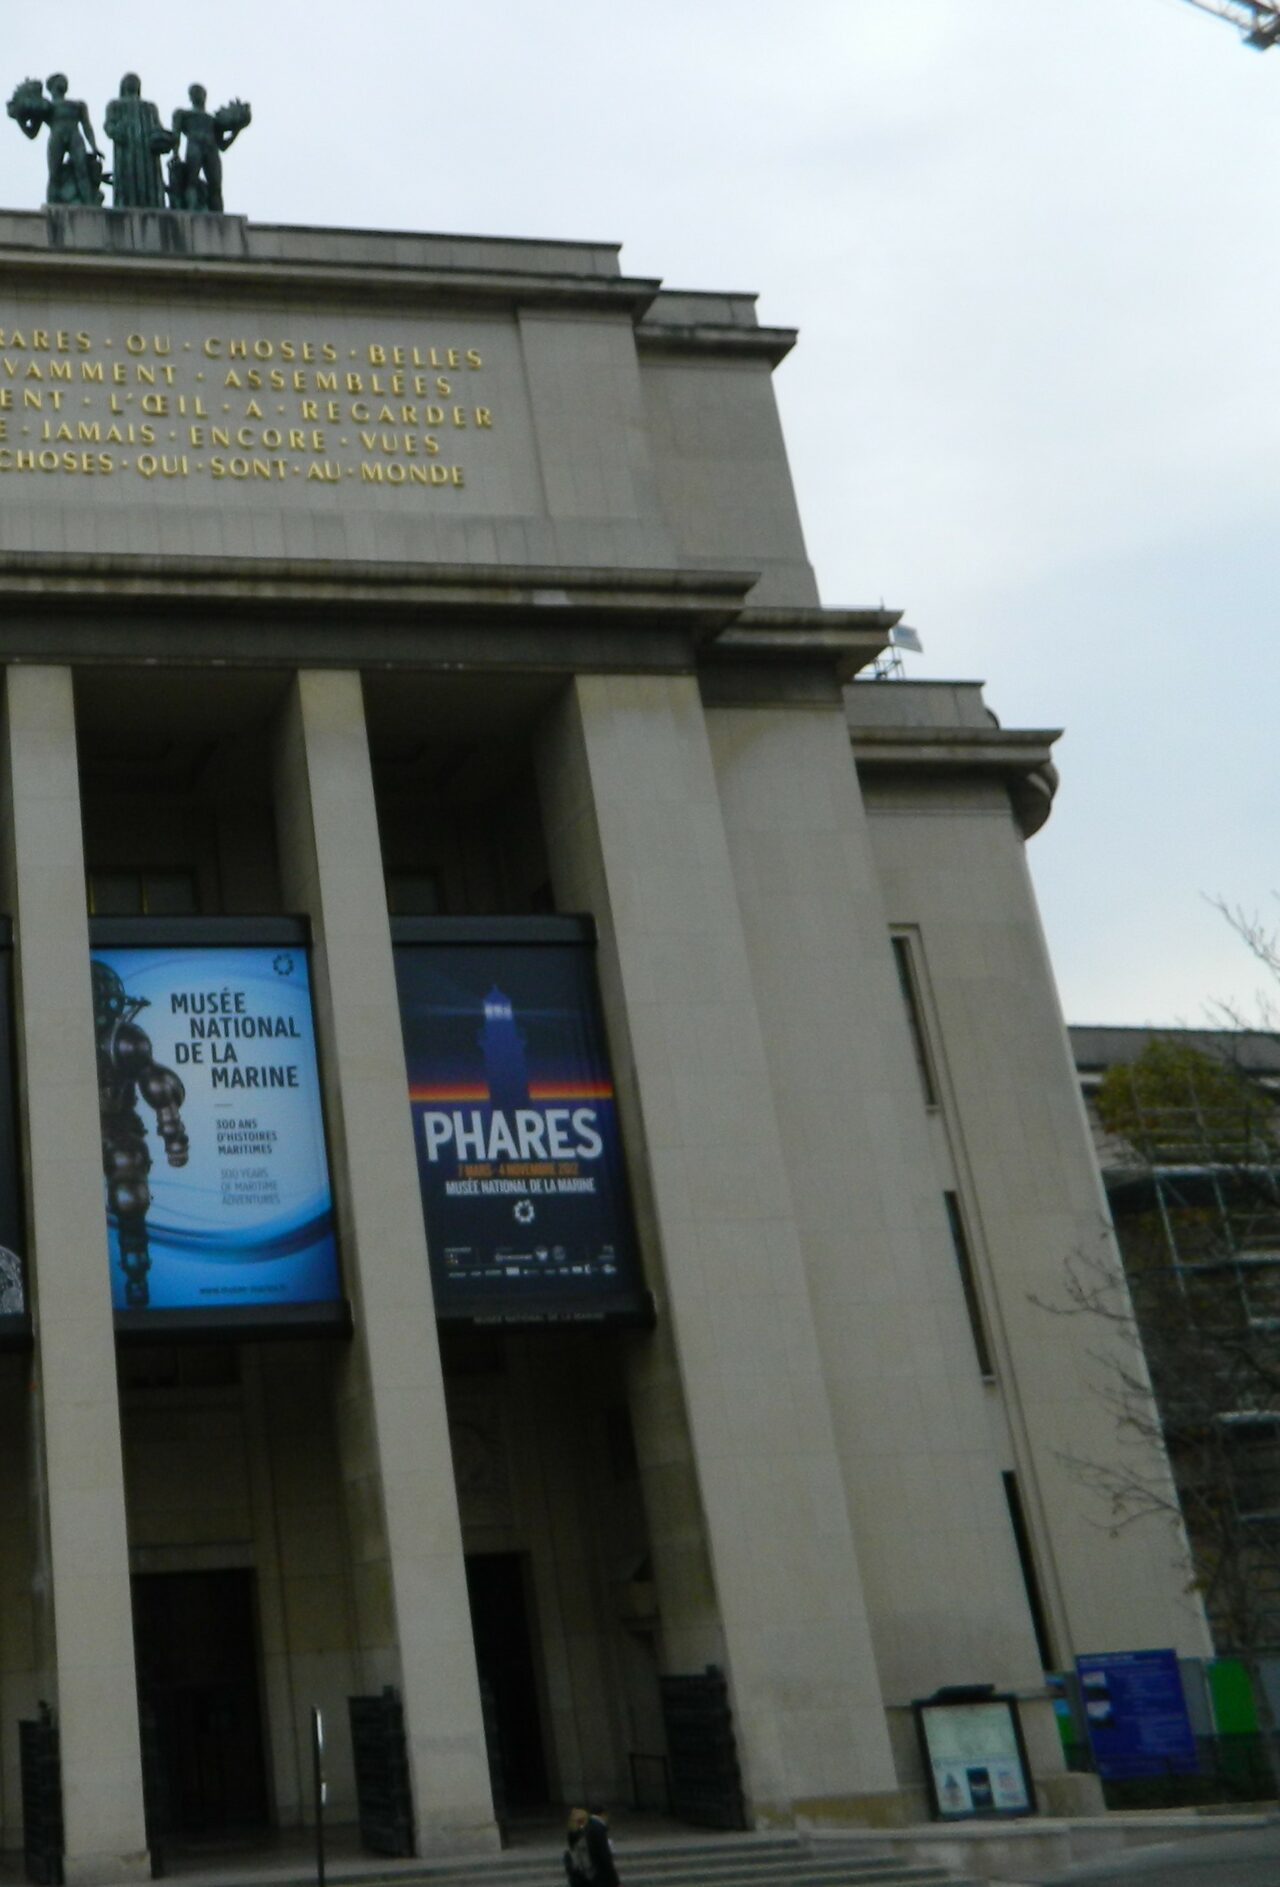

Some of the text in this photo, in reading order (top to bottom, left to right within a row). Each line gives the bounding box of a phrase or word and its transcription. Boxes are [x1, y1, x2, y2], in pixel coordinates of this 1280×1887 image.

[127, 334, 171, 356] OU
[205, 338, 337, 362] CHOSES
[370, 344, 482, 369] BELLES
[225, 368, 451, 398] ASSEMBLÉES
[246, 399, 264, 420] A
[302, 400, 493, 427] REGARDER
[190, 425, 325, 451] ENCORE
[360, 431, 439, 454] VUES
[137, 454, 188, 477] QUI
[211, 457, 288, 480] SONT
[308, 462, 341, 484] AU
[361, 462, 465, 486] MONDE
[170, 987, 246, 1014] MUSÉE
[190, 1016, 301, 1038] NATIONAL
[175, 1041, 238, 1064] DE LA
[211, 1065, 300, 1088] MARINE
[238, 1118, 257, 1129] ANS
[423, 1108, 603, 1162] PHARES
[218, 1144, 272, 1155] MARITIMES
[445, 1177, 596, 1195] MUSÉE NATIONAL DE LA MARINE
